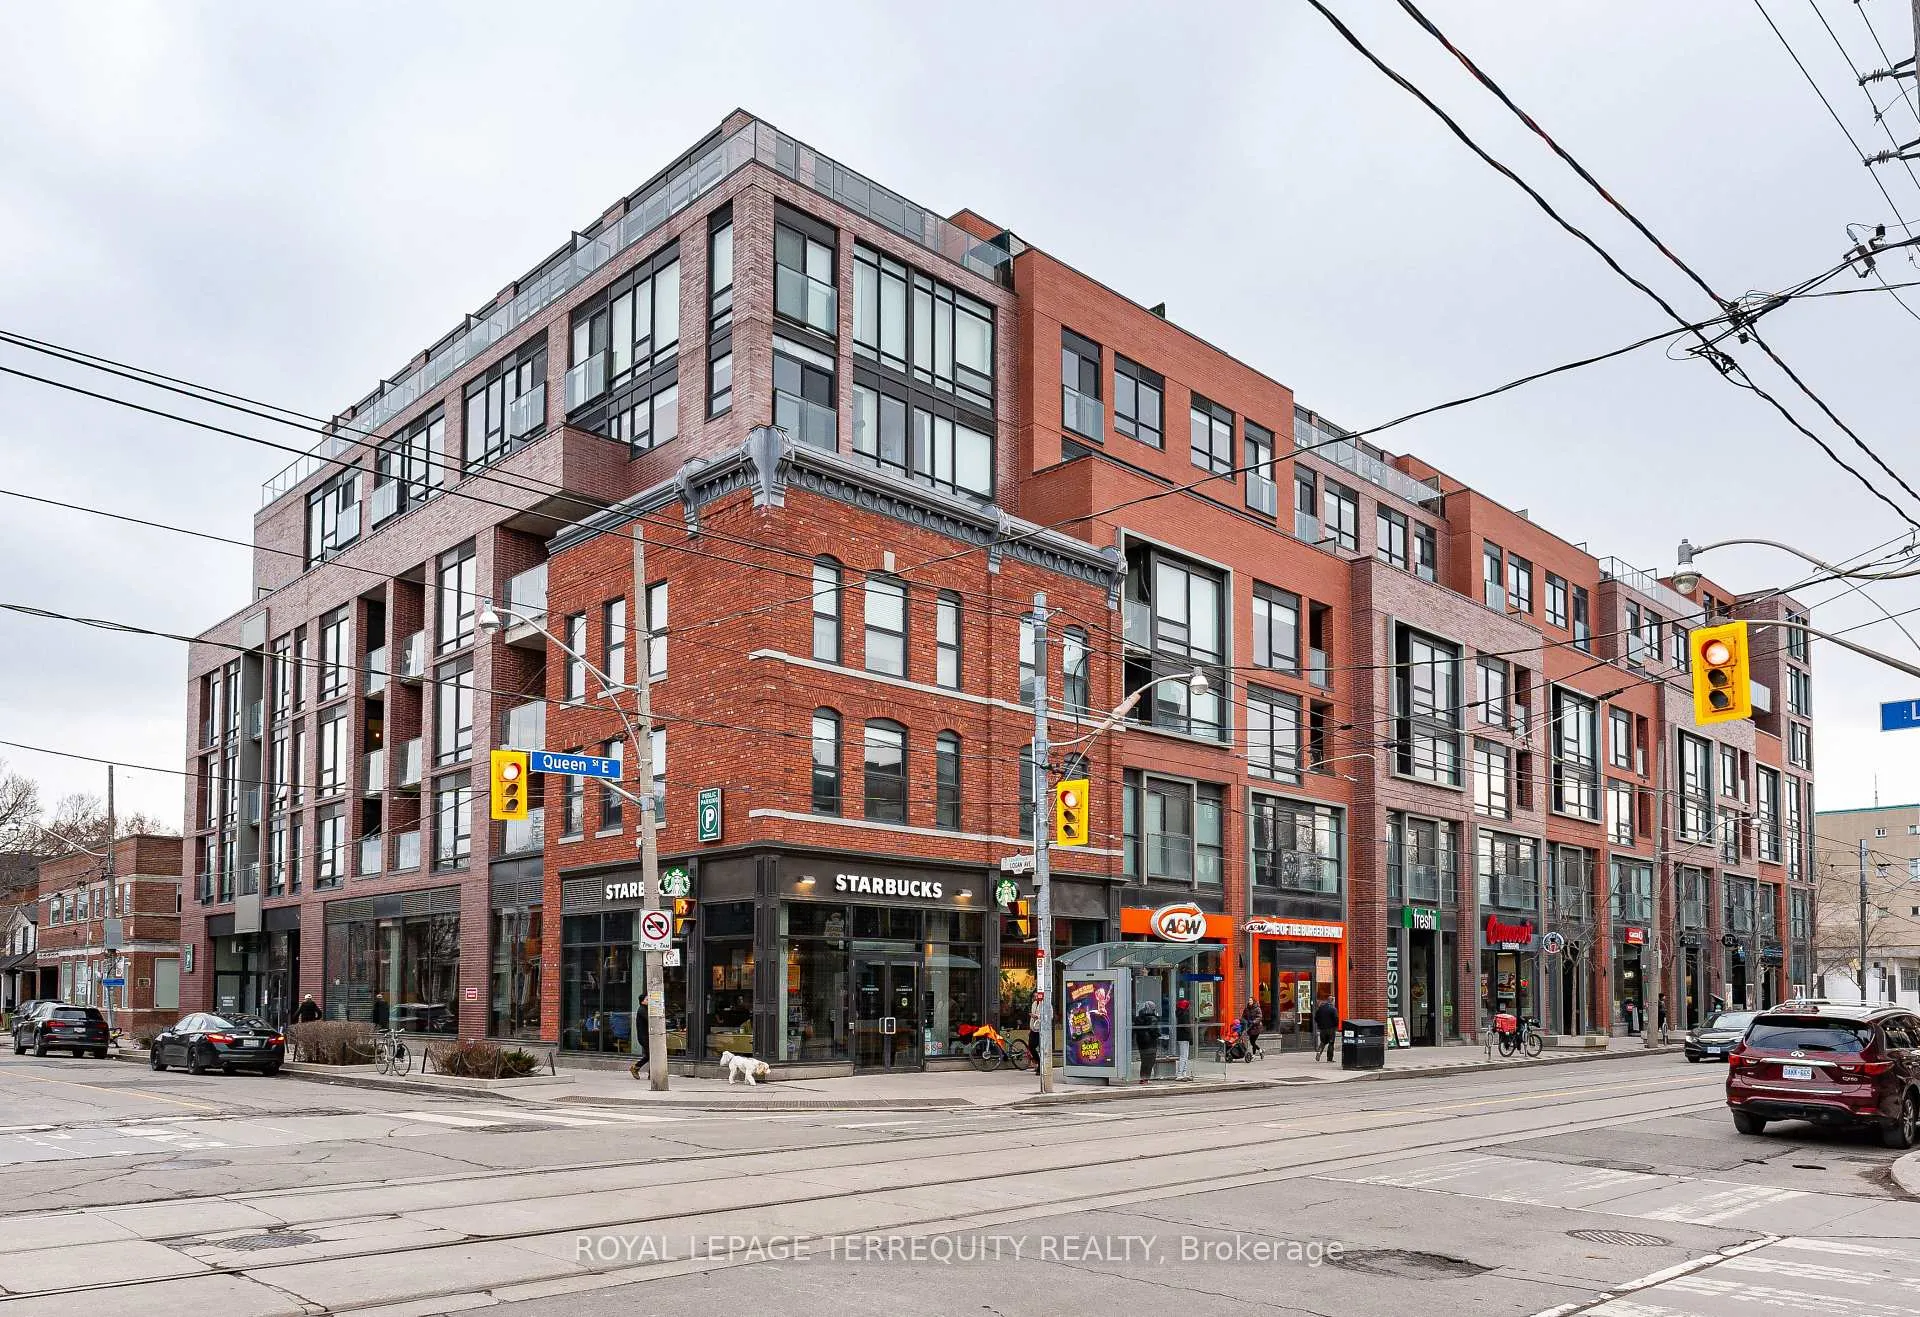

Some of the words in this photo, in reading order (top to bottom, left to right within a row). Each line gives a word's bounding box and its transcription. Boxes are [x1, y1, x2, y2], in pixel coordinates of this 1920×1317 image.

[543, 755, 587, 772] Queen
[592, 759, 599, 767] St
[601, 760, 609, 774] E
[705, 808, 715, 829] P
[835, 873, 943, 899] STARBUCKS
[1164, 917, 1202, 935] A&W
[1413, 908, 1437, 930] freshii
